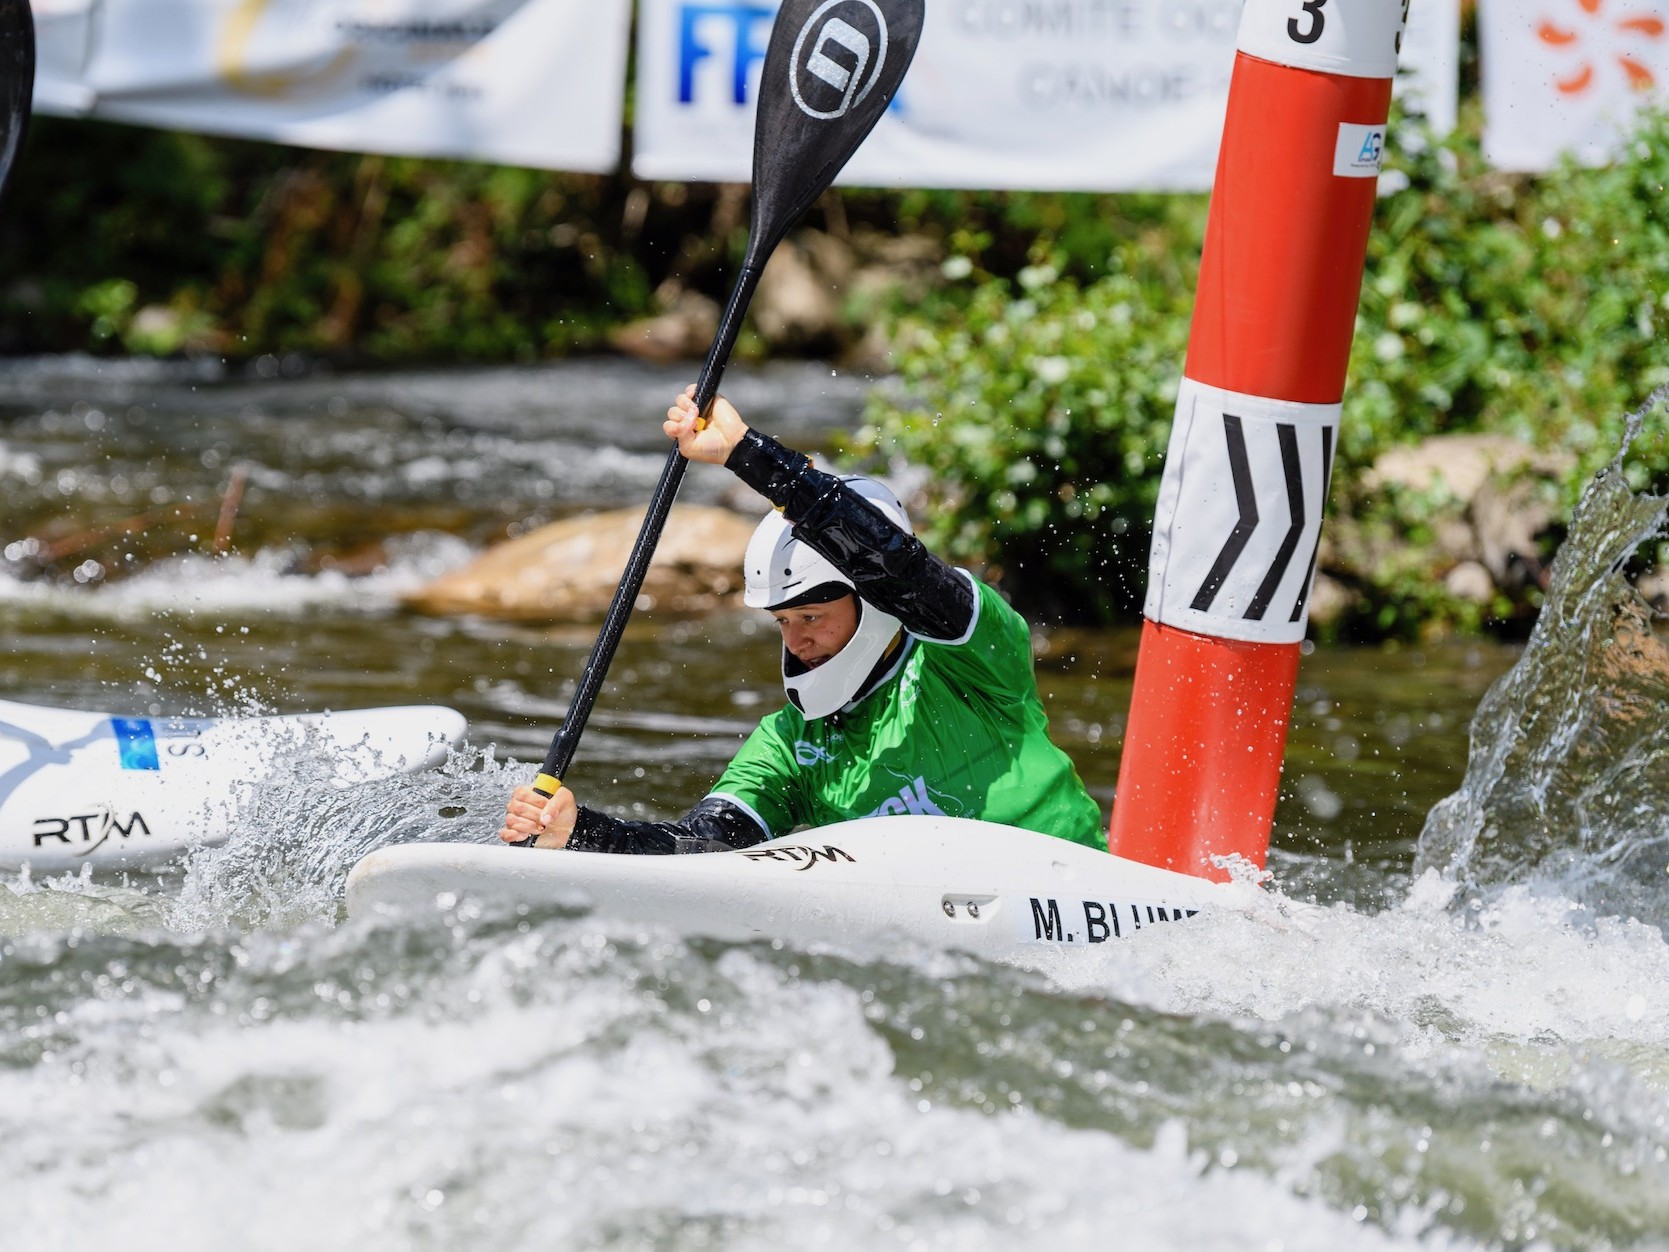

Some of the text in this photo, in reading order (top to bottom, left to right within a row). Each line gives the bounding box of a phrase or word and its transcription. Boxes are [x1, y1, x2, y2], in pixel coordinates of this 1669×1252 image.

[1287, 0, 1327, 44] 3
[33, 811, 150, 847] RTM
[736, 845, 857, 871] RTM
[1029, 897, 1073, 942] M.
